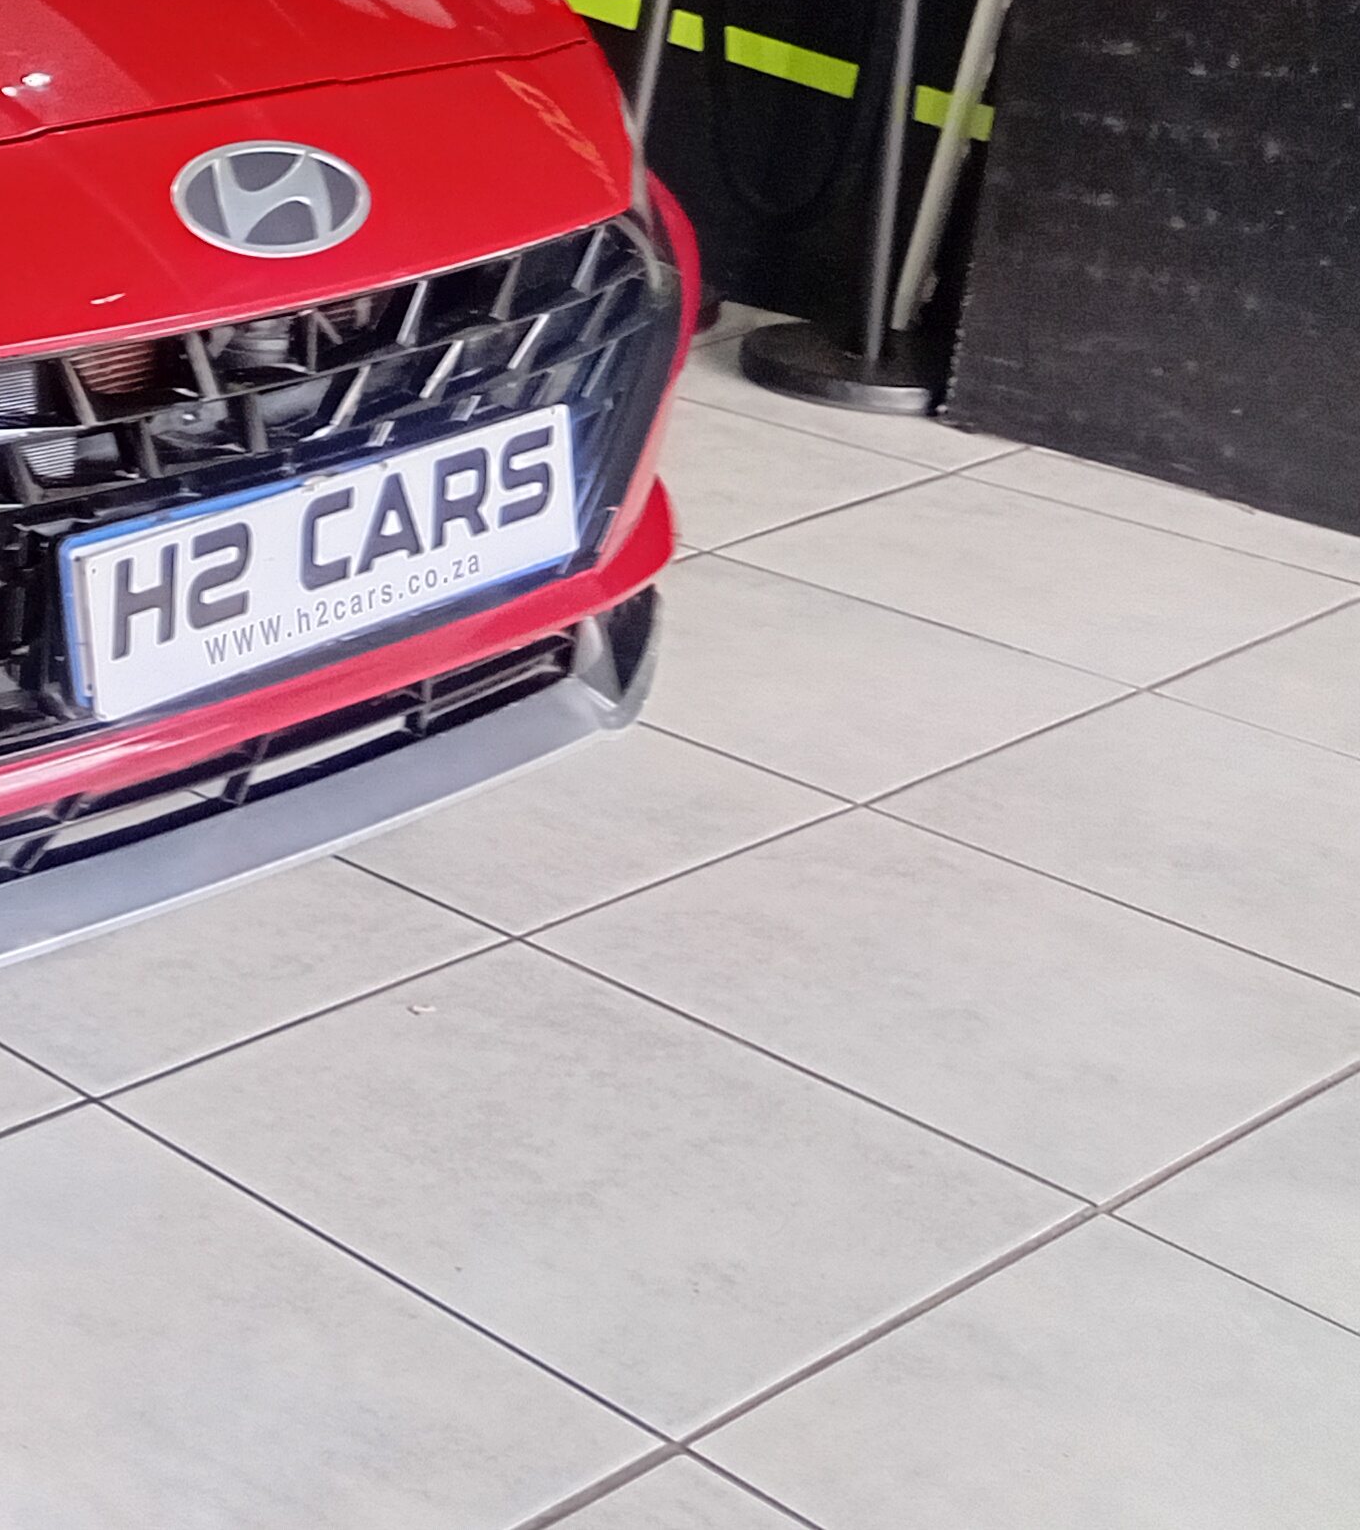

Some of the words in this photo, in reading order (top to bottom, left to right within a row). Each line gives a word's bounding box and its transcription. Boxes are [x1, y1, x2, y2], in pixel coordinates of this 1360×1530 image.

[111, 521, 251, 661] H2
[298, 425, 555, 592] CARS
[204, 551, 482, 666] www.h2cars.co.za
